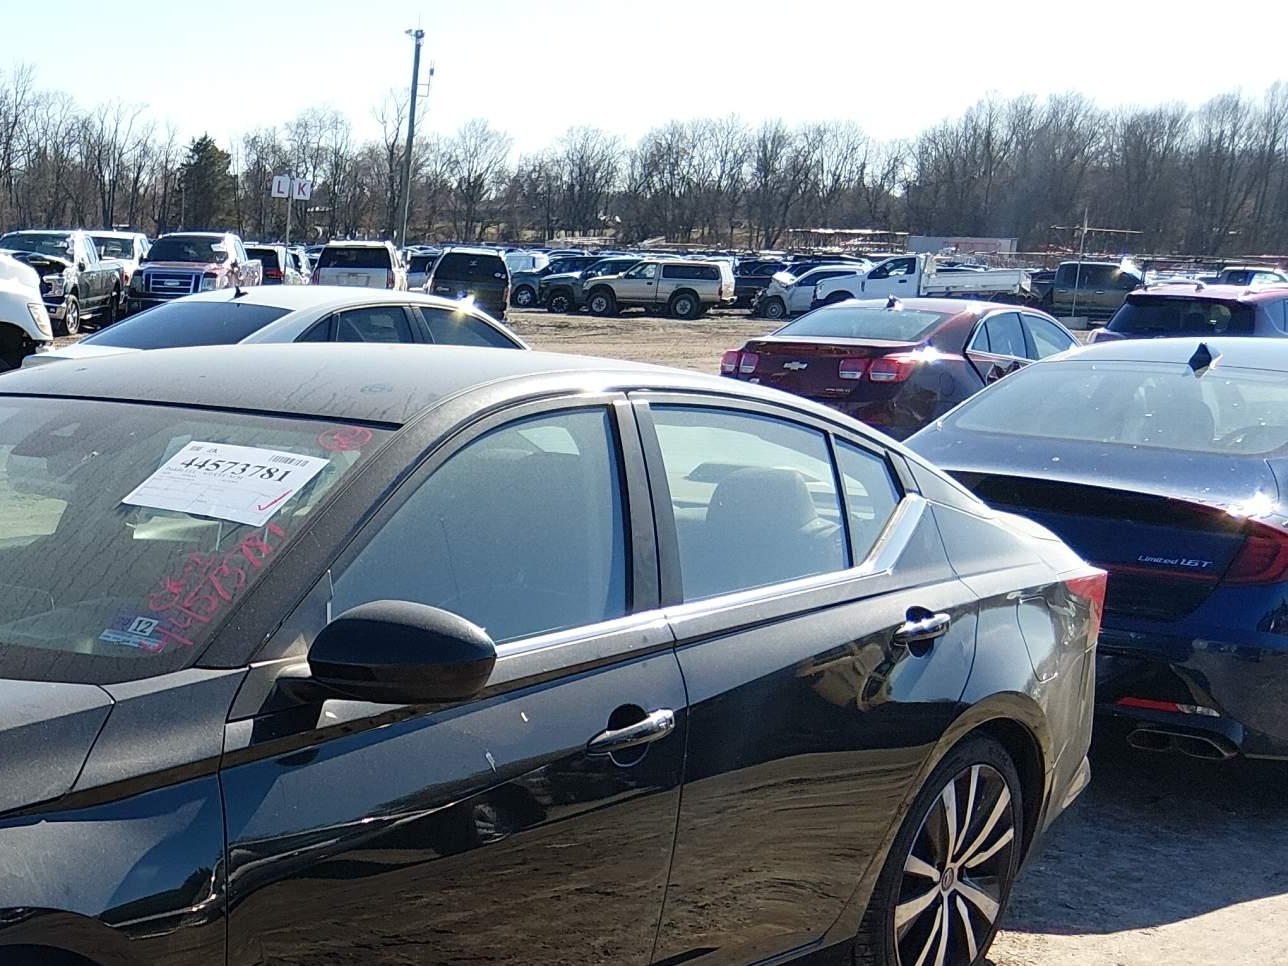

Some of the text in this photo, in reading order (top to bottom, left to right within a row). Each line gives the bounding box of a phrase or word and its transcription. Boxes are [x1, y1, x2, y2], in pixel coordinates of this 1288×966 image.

[277, 180, 285, 194] L
[297, 182, 308, 196] K
[181, 456, 292, 482] 44573781
[1137, 555, 1178, 564] Limited
[133, 620, 153, 634] 12
